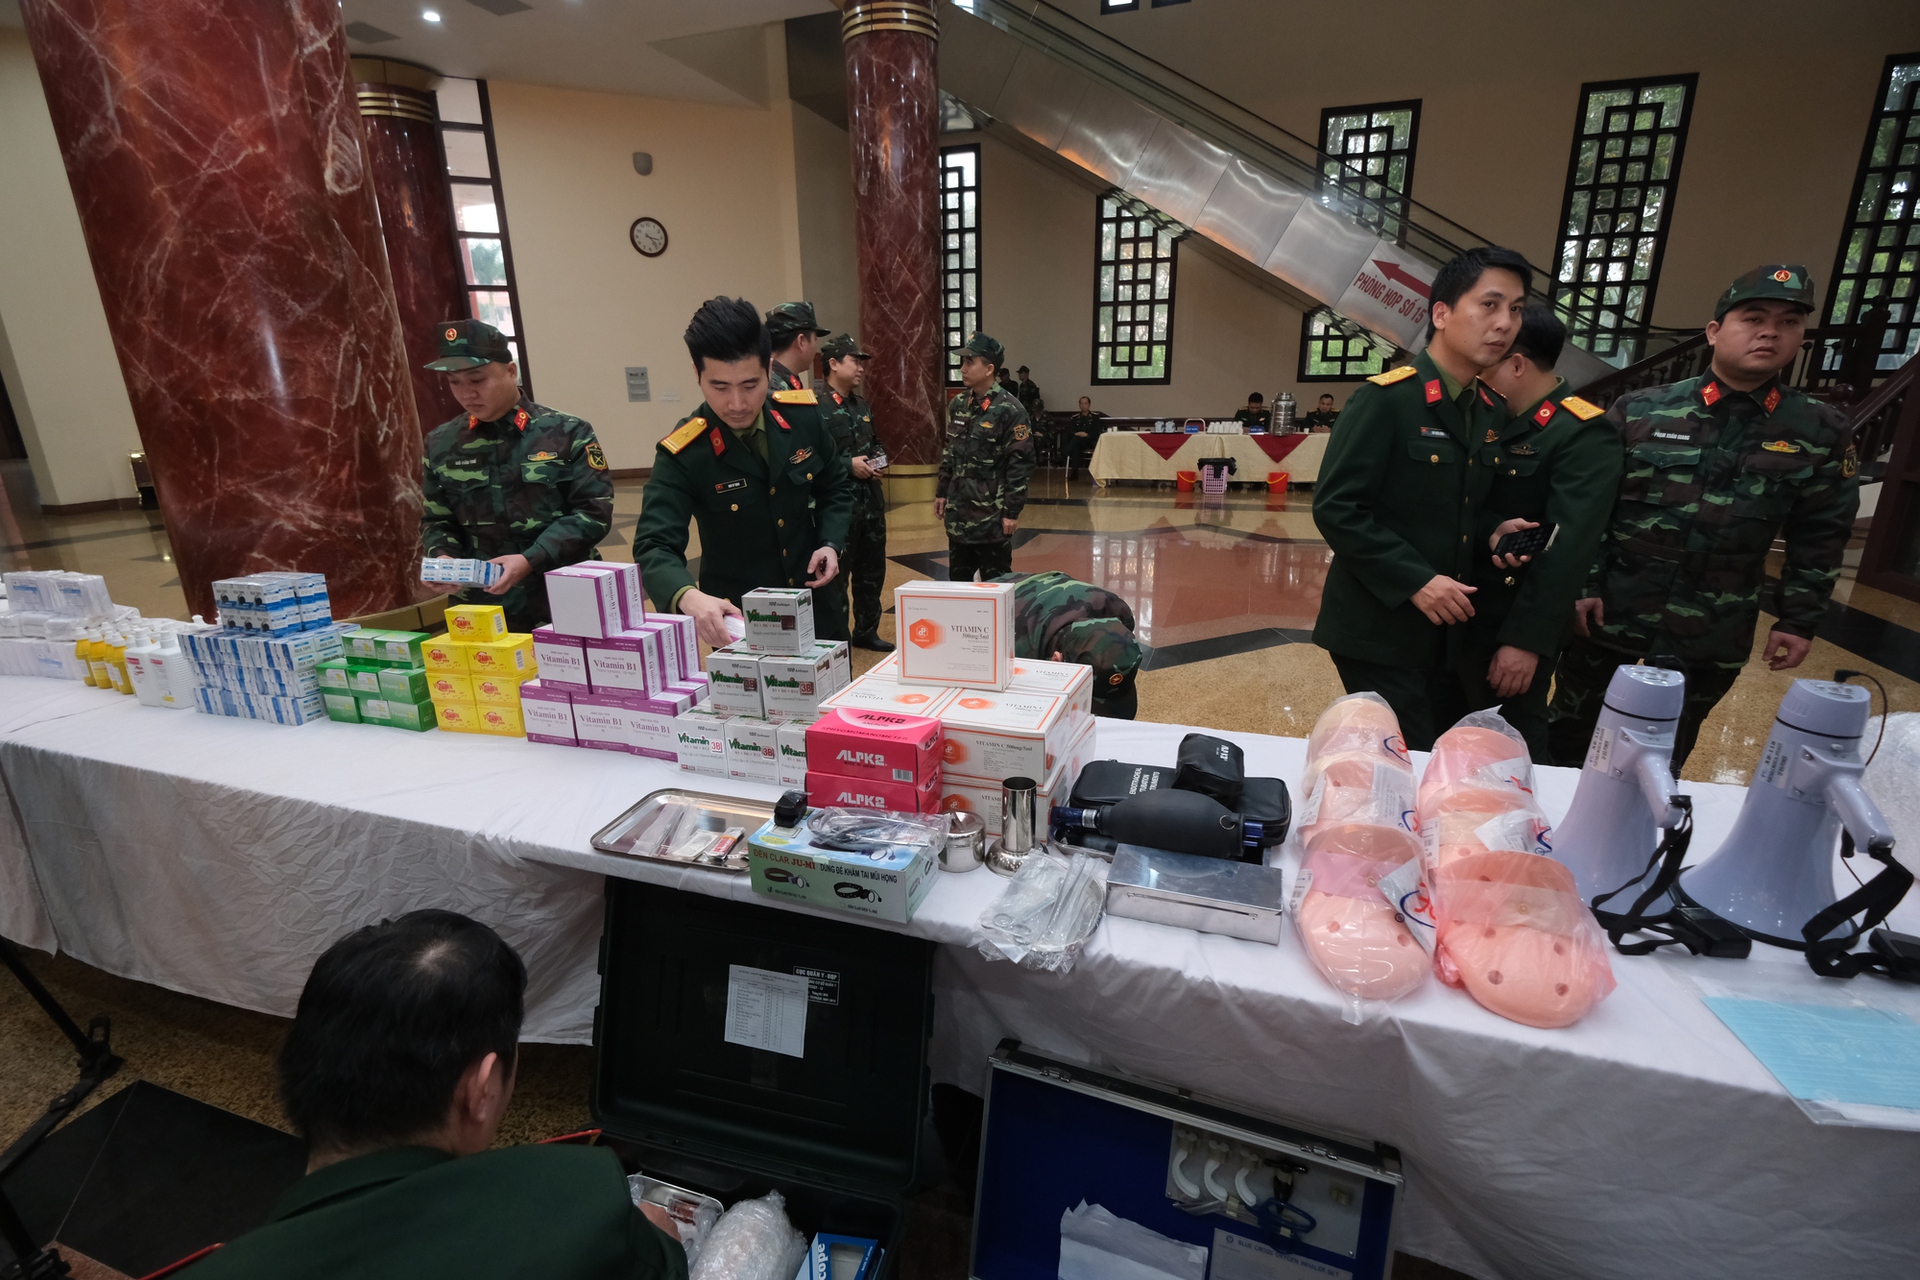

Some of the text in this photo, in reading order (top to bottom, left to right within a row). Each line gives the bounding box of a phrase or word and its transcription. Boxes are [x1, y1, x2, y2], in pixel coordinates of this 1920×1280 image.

[1382, 288, 1403, 309] HỌP
[1398, 299, 1420, 316] SỐ
[1411, 307, 1427, 324] 15
[746, 609, 782, 623] Vitamin
[541, 654, 580, 666] Vitamin B1
[594, 660, 625, 670] Vitamin
[710, 670, 744, 684] Vitamin
[764, 675, 812, 693] Vitamin 3B
[528, 709, 556, 719] Vitamin
[580, 715, 611, 724] Vitamin
[857, 714, 906, 724] ALPK2
[630, 721, 659, 732] Vitamin
[661, 725, 670, 733] B1
[678, 732, 709, 745] Vitamin
[712, 742, 721, 750] 3B
[729, 738, 773, 757] Vitamin 3B
[925, 732, 939, 749] ALPK2
[781, 744, 806, 757] Vitam
[836, 750, 884, 766] ALPK2
[925, 772, 938, 789] ALPK2
[1129, 768, 1142, 794] ENDOTRACHEAL
[836, 792, 884, 808] ALPK2
[770, 853, 790, 864] CLAR
[791, 860, 816, 869] JU-MI
[881, 875, 897, 884] HỌNG
[817, 1243, 828, 1280] cope
[1238, 1240, 1339, 1277] BLUE CROSS OXYGEN INHALER SET
